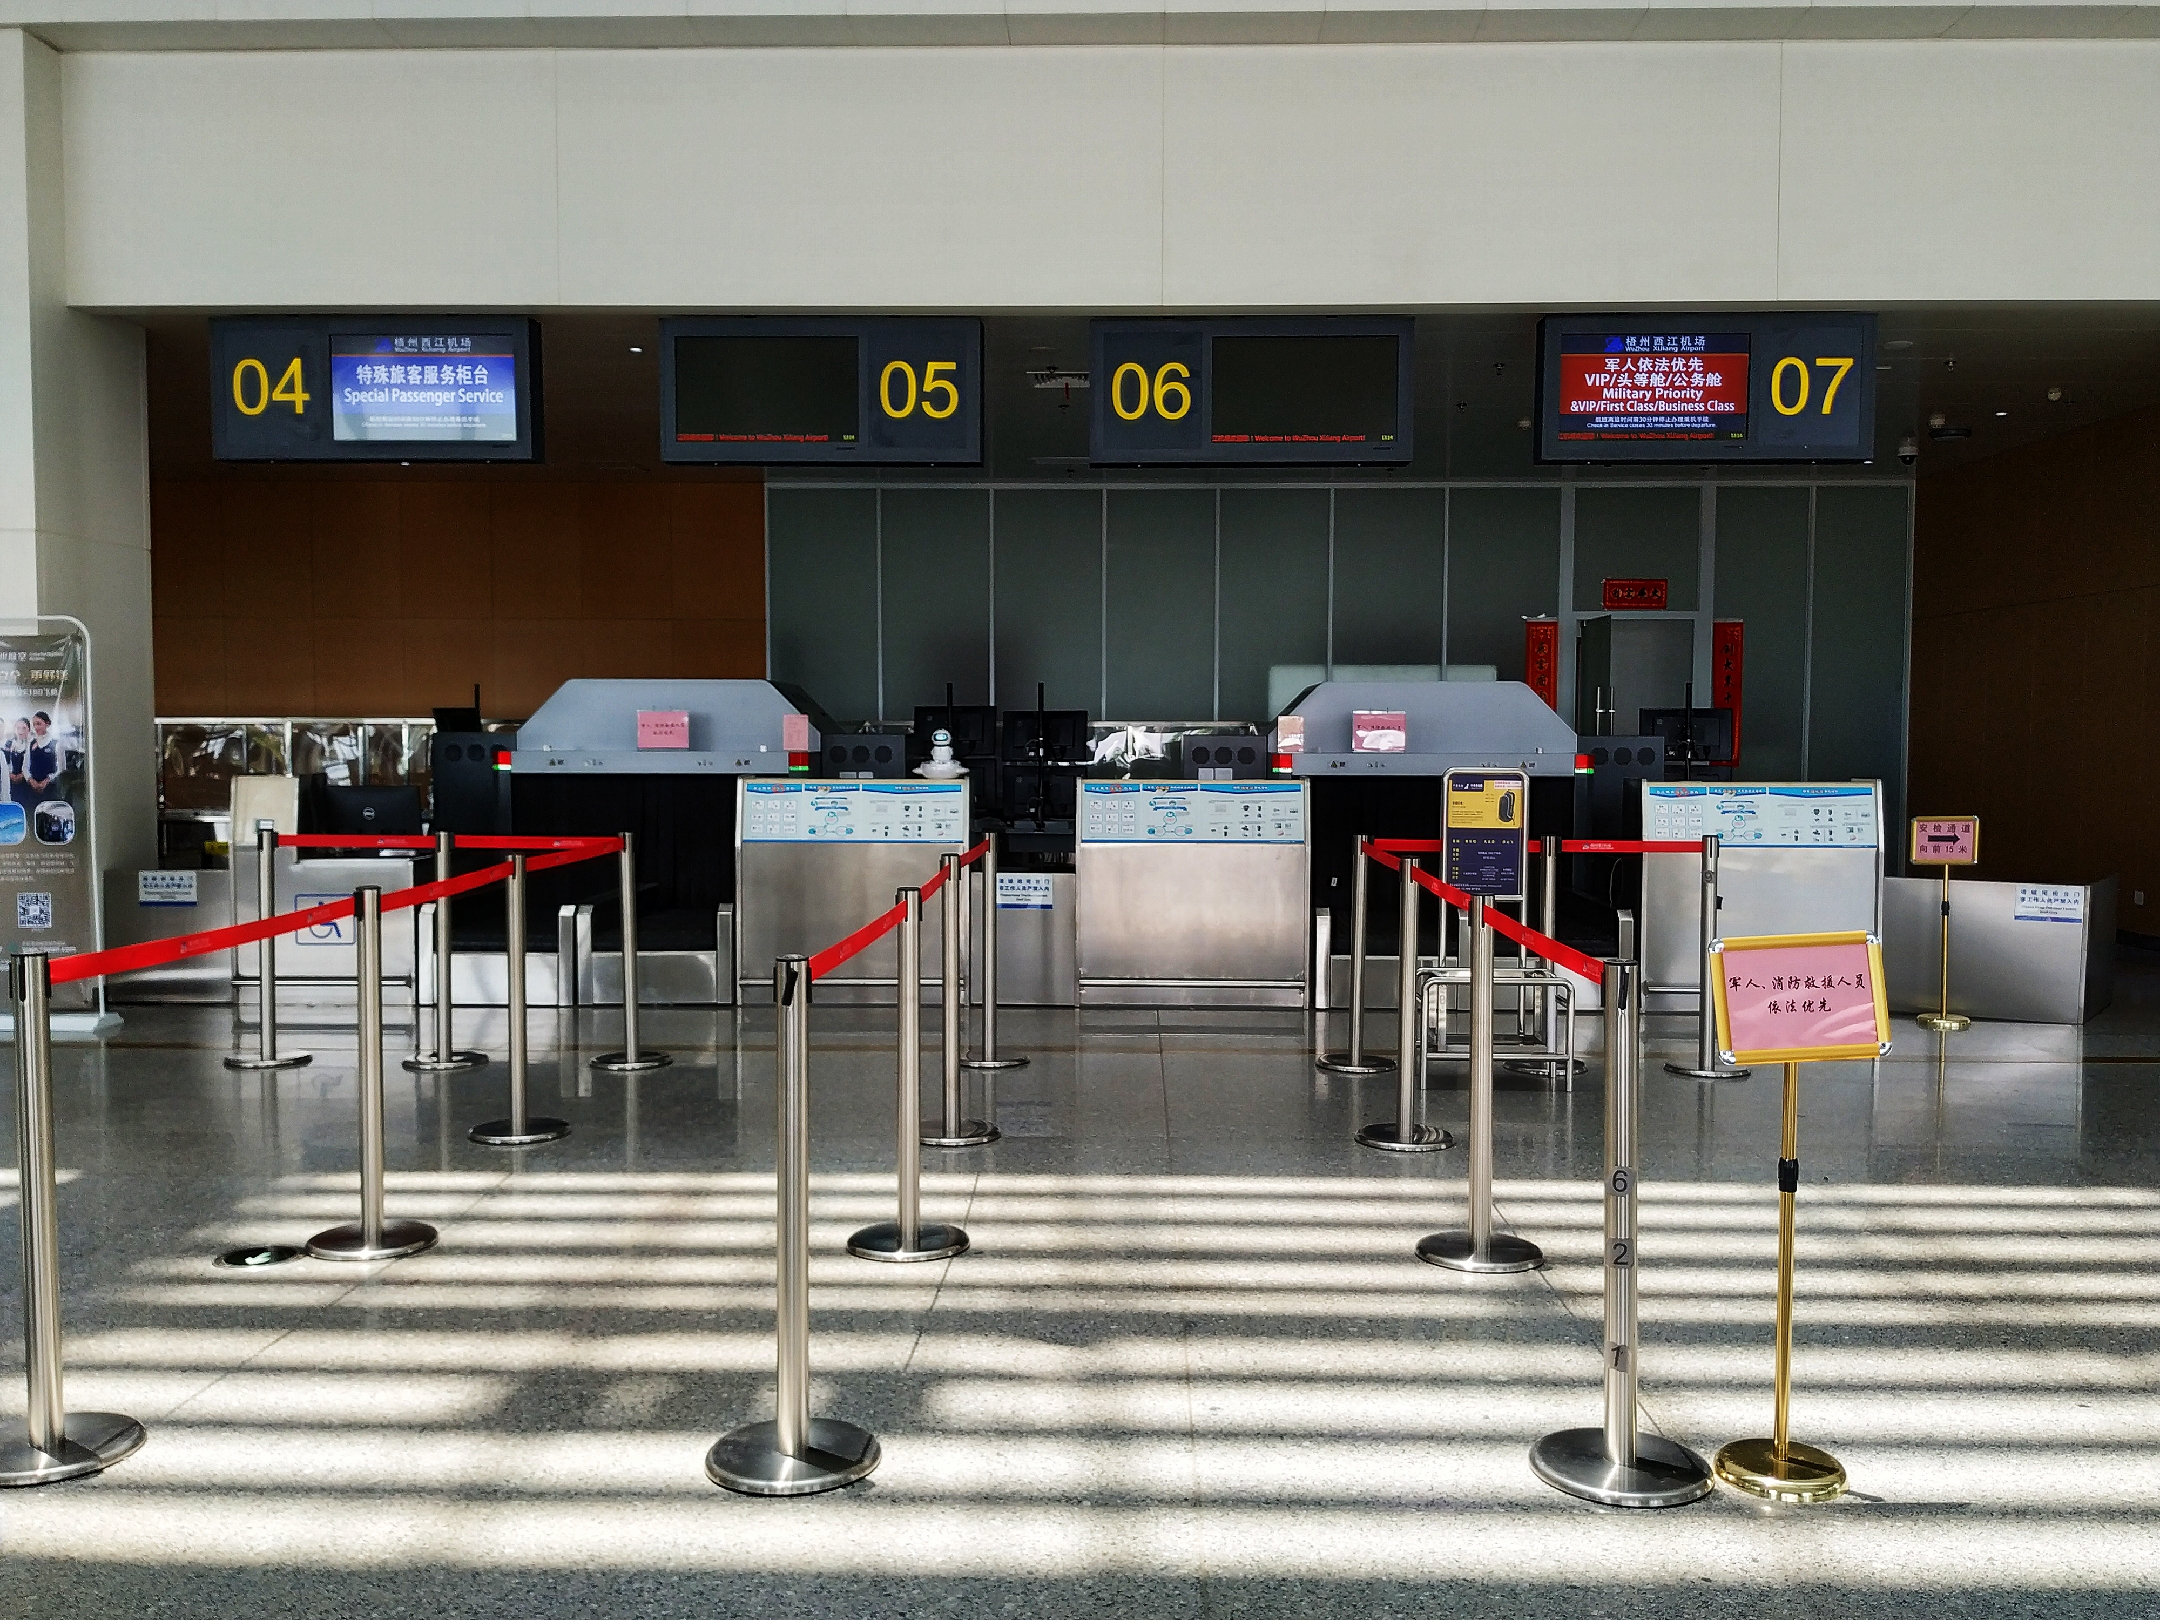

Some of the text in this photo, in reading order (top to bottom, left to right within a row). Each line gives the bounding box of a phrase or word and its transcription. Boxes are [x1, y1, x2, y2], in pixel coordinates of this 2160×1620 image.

[1625, 335, 1706, 347] 梧州西江机场
[1604, 357, 1704, 372] 军人依法优先
[355, 364, 489, 386] 特殊旅客服务柜台
[1584, 373, 1723, 388] VIP/头等舱/公务舱
[232, 357, 310, 416] 04
[879, 360, 960, 419] 05
[1111, 361, 1192, 421] 06
[1602, 387, 1704, 401] Military Priority
[1771, 356, 1855, 416] 07
[344, 387, 504, 407] Special Passenger Service
[1570, 400, 1735, 413] &VIP/First Class/Business Class
[1918, 823, 1971, 834] 安检通道
[1919, 845, 1968, 854] 向前15米
[1728, 973, 1867, 992] 军人、消防救援人员
[1767, 998, 1832, 1015] 依法优先
[1611, 1169, 1629, 1193] 6
[1612, 1242, 1629, 1266] 2
